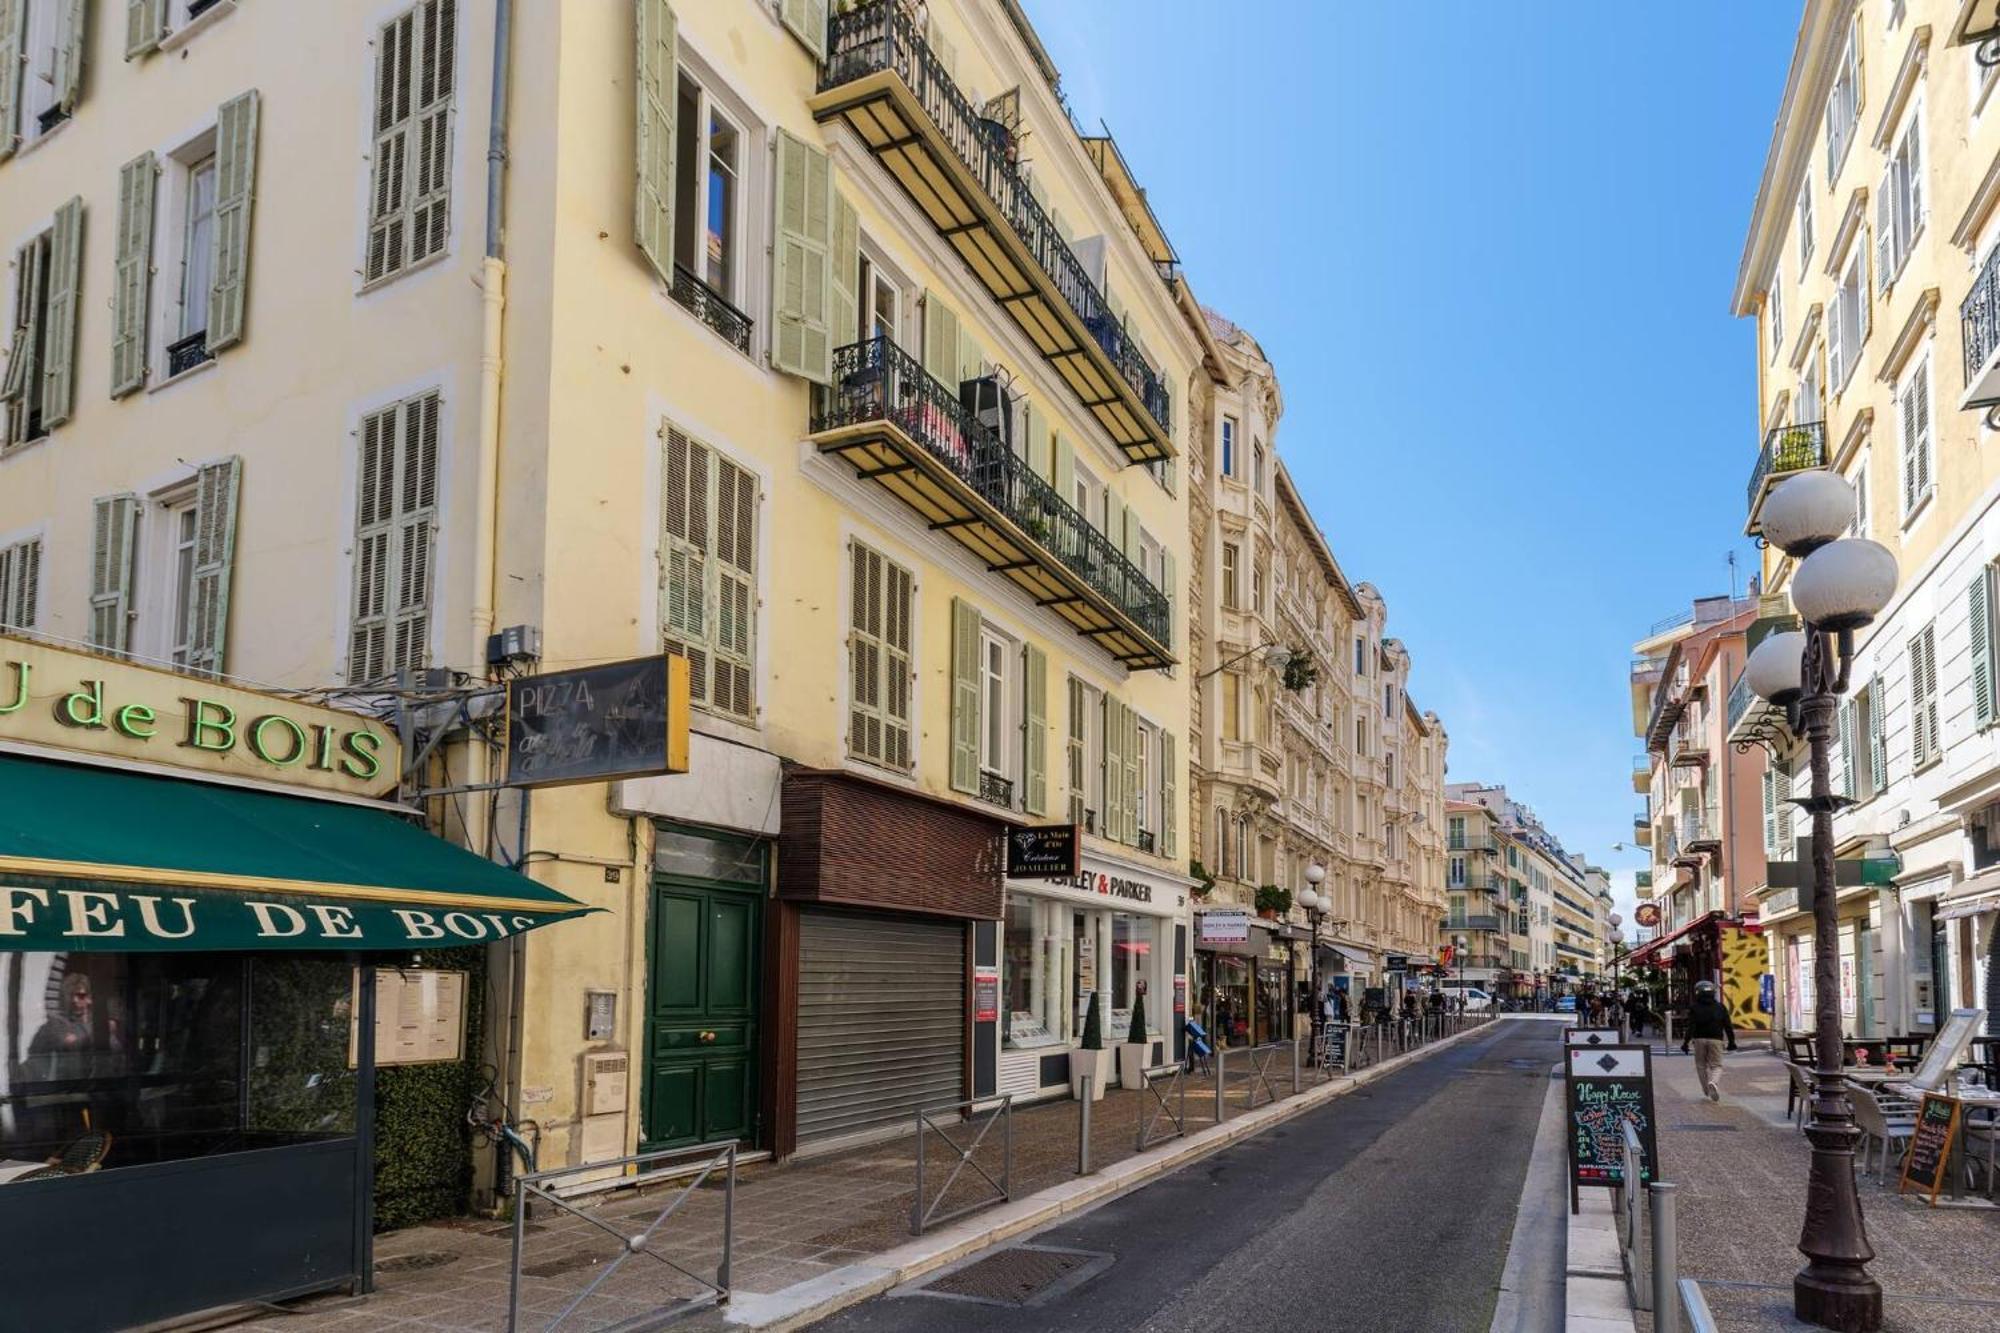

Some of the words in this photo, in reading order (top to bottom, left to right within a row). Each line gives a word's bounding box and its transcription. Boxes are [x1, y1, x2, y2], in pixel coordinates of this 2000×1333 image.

[520, 680, 594, 718] PIZZA
[53, 680, 158, 740] de
[177, 697, 382, 780] BOIS
[1097, 874, 1108, 895] &
[1110, 877, 1152, 902] PARKER
[0, 886, 197, 938] FEU
[245, 902, 363, 938] DE
[1576, 1083, 1608, 1105] Happy
